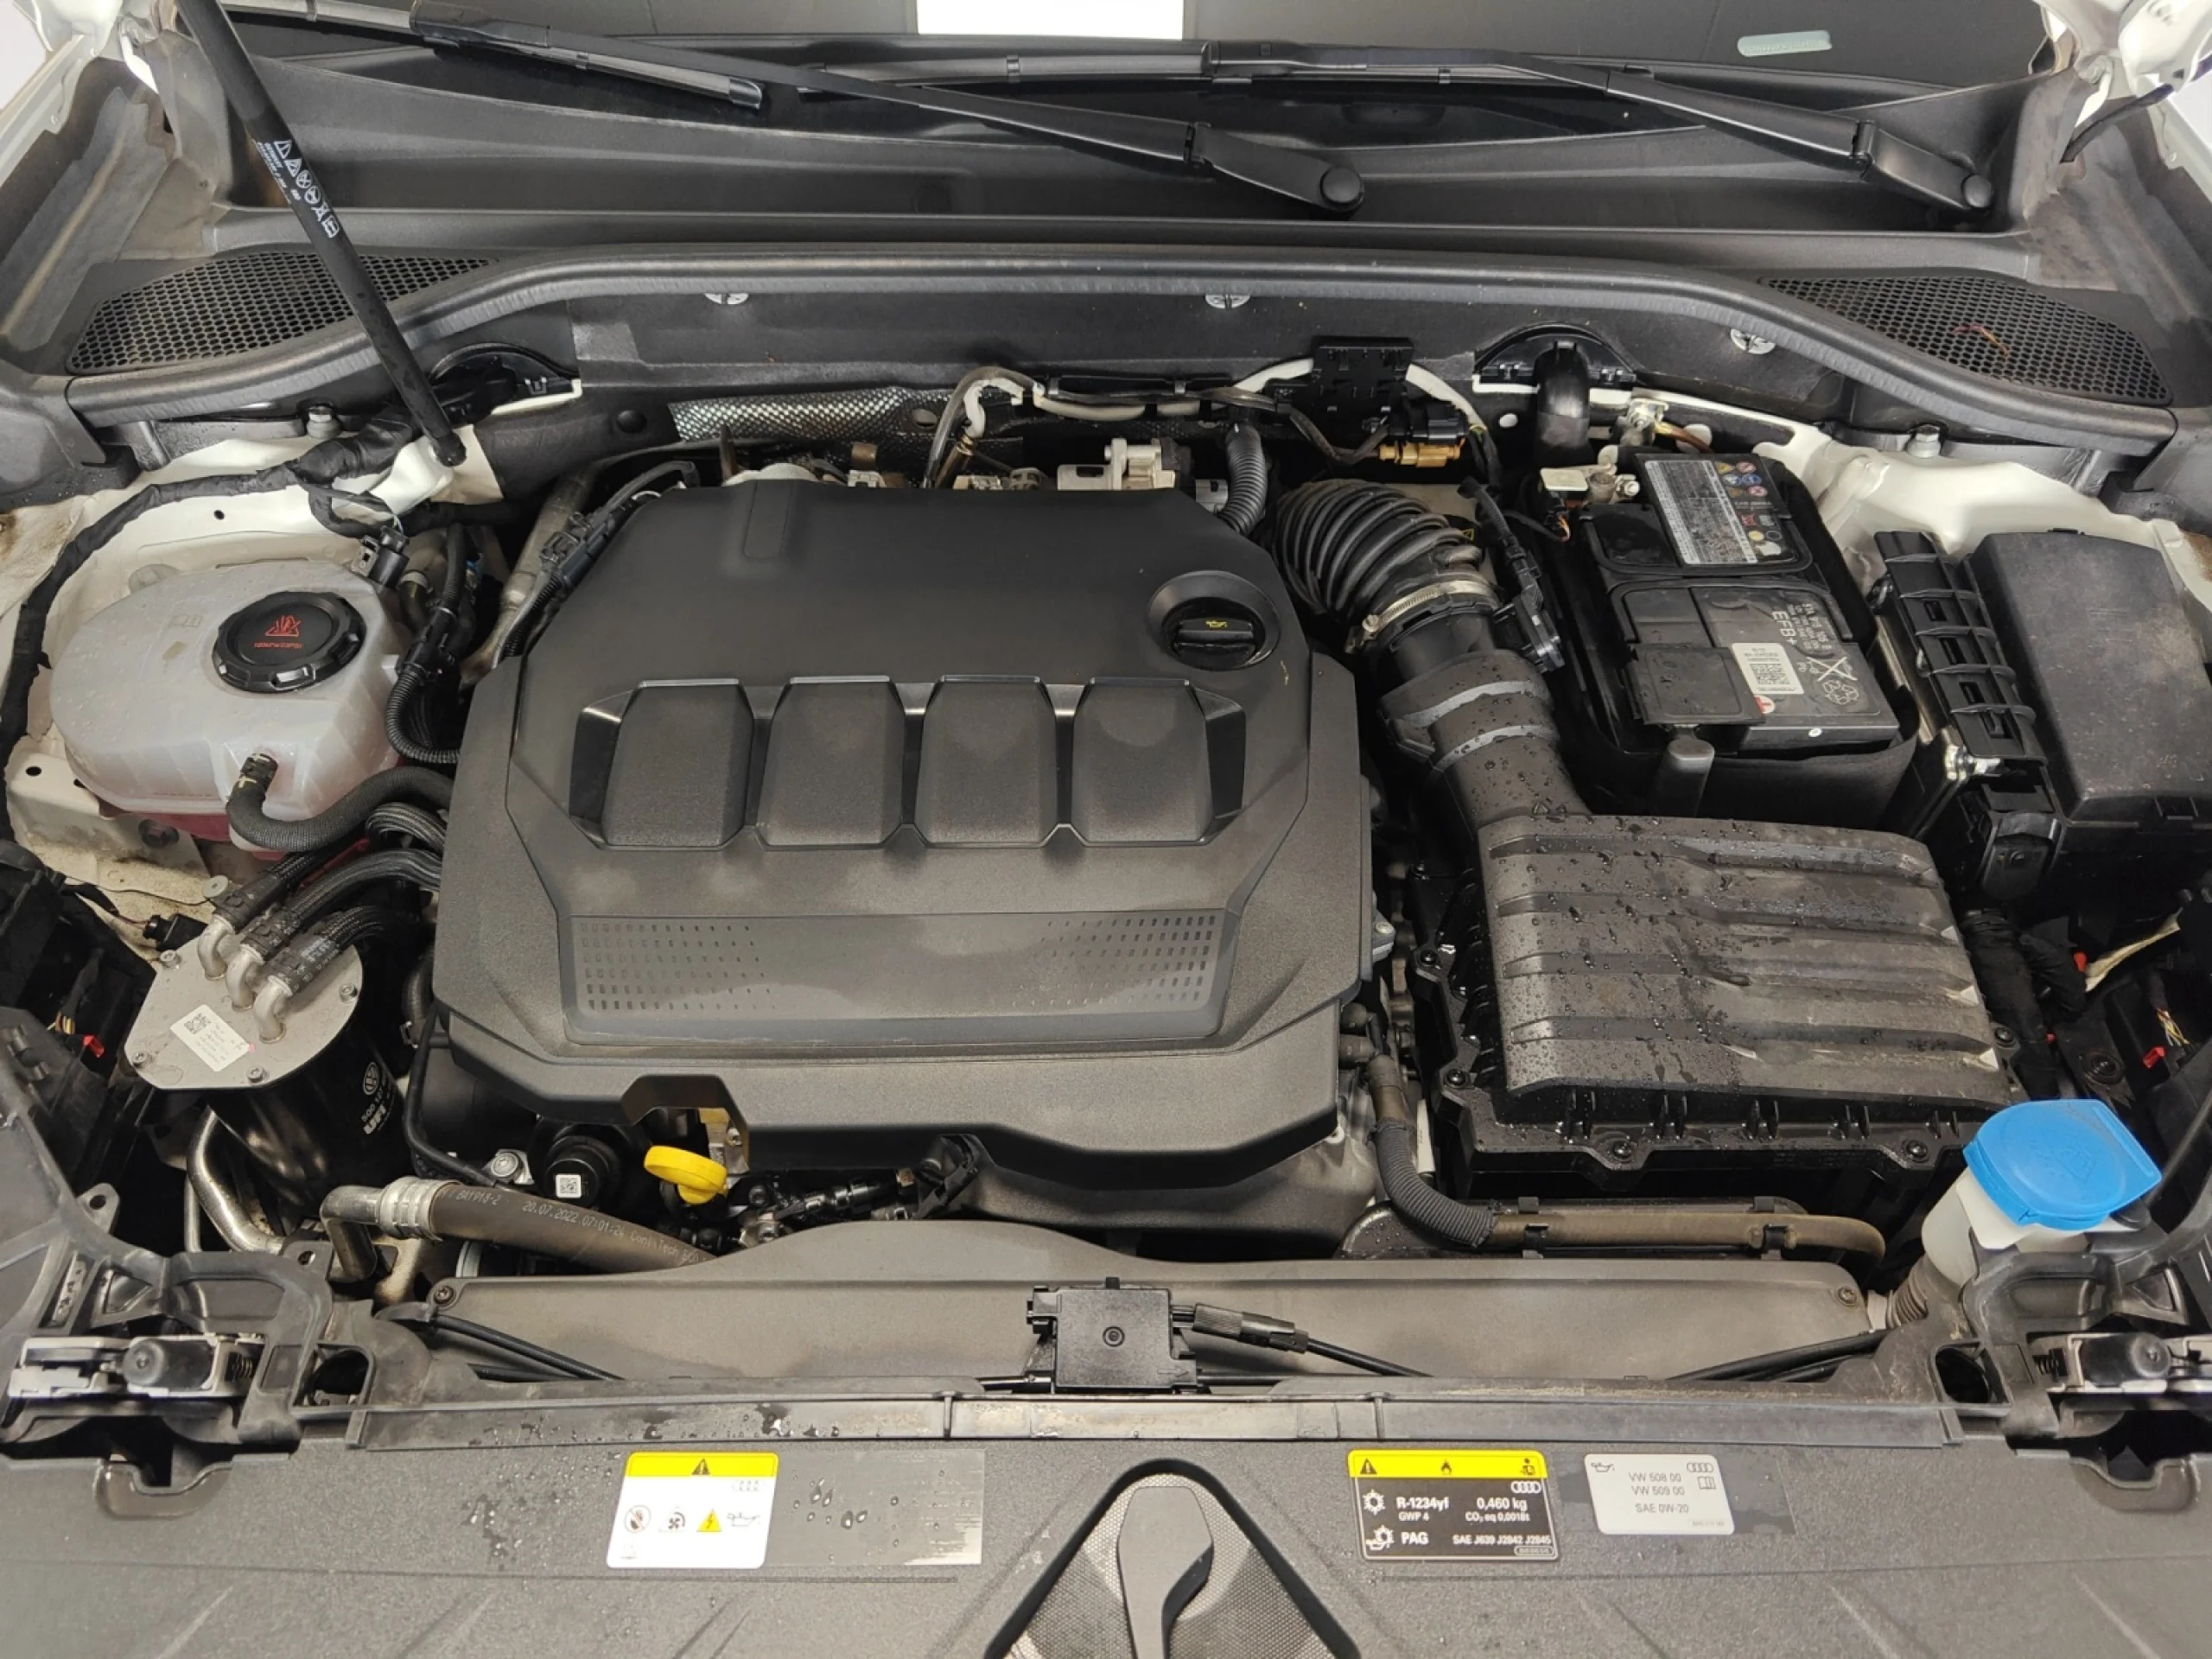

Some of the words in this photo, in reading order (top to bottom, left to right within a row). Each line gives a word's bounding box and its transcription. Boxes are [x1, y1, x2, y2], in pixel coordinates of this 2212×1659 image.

[1772, 610, 1797, 645] EFB+
[1629, 1472, 1647, 1483] VW
[1649, 1472, 1668, 1483] 508
[1669, 1472, 1682, 1483] 00
[1631, 1486, 1649, 1496] VW
[1652, 1486, 1671, 1496] 509
[1673, 1486, 1685, 1496] 00
[1395, 1496, 1449, 1512] R-1234yf
[1476, 1497, 1510, 1511] 0,460
[1511, 1497, 1529, 1512] kg
[1635, 1503, 1656, 1513] SAE
[1658, 1503, 1689, 1514] 0W-20
[1398, 1511, 1421, 1522] GWP
[1401, 1531, 1429, 1545] PAG
[1452, 1534, 1472, 1545] SAE
